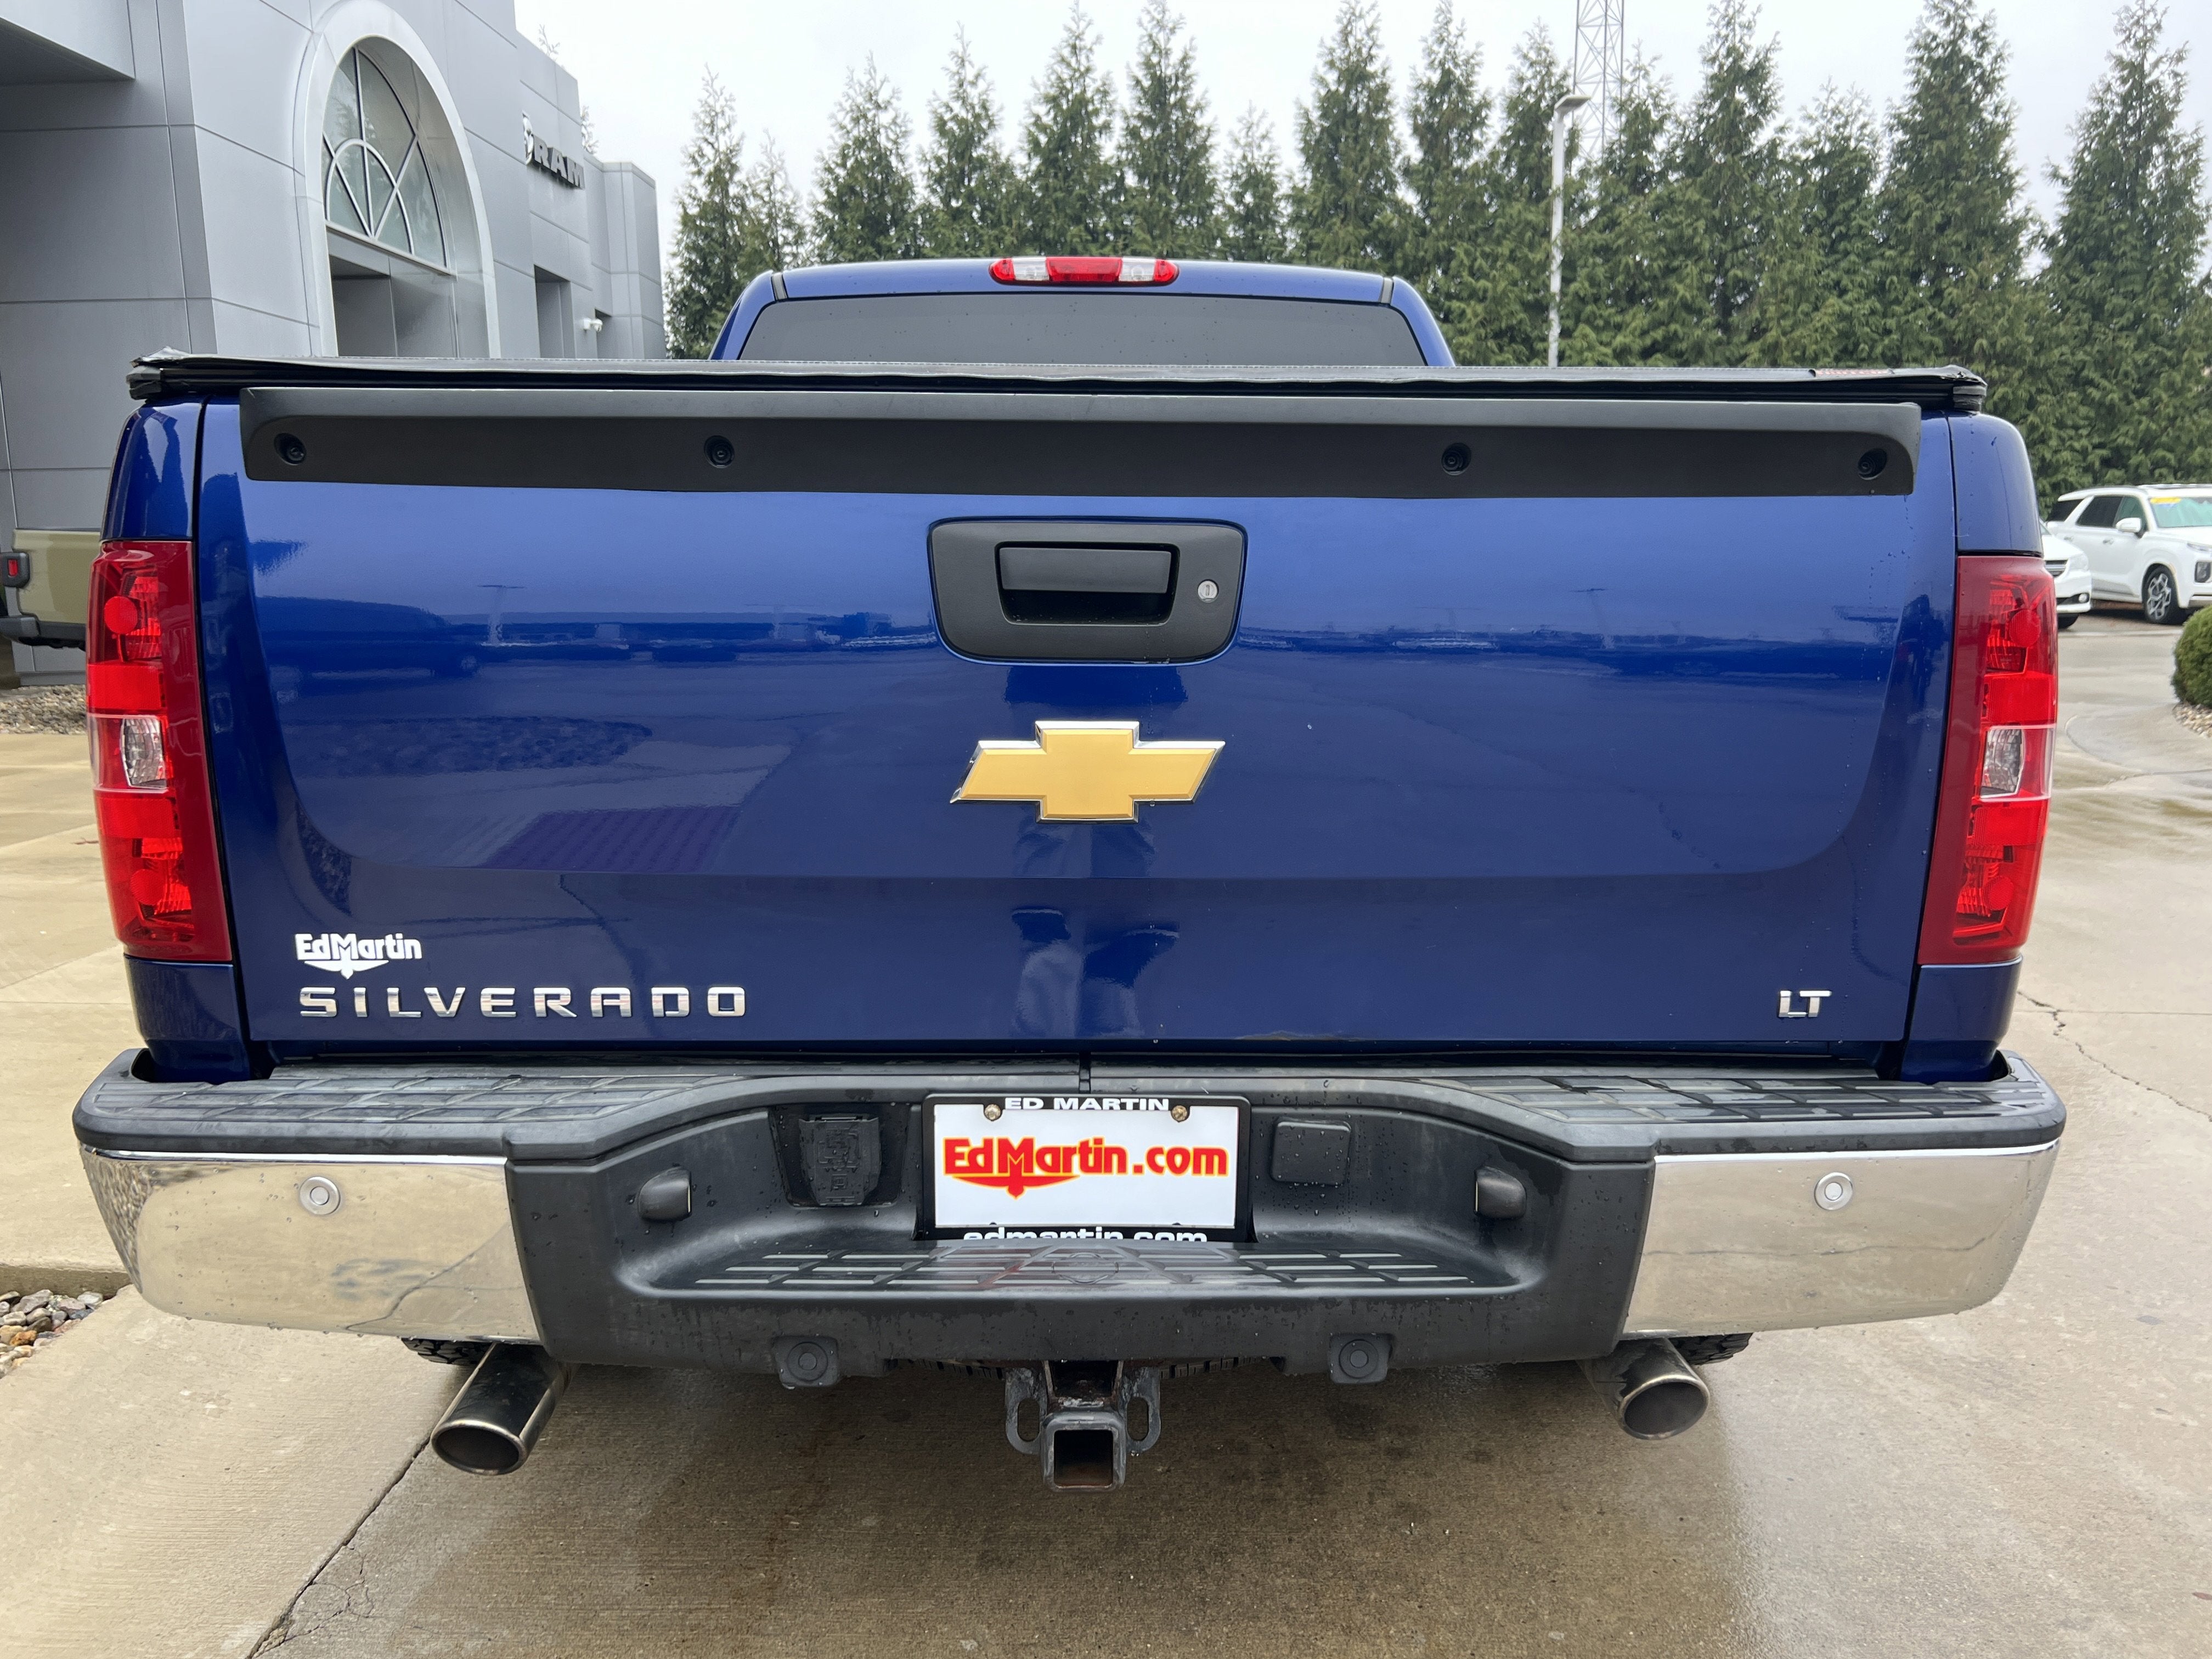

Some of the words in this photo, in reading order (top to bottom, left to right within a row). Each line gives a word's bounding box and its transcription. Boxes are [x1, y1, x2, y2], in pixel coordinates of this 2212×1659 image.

[534, 135, 585, 189] RAM
[295, 933, 422, 961] EdMartin
[300, 987, 746, 1018] SILVERADO
[1778, 990, 1832, 1018] LT
[1005, 1097, 1043, 1110] ED
[1053, 1097, 1169, 1111] MARTIN
[943, 1136, 1229, 1177] EdMartin.com
[963, 1226, 1207, 1242] edmartincom
